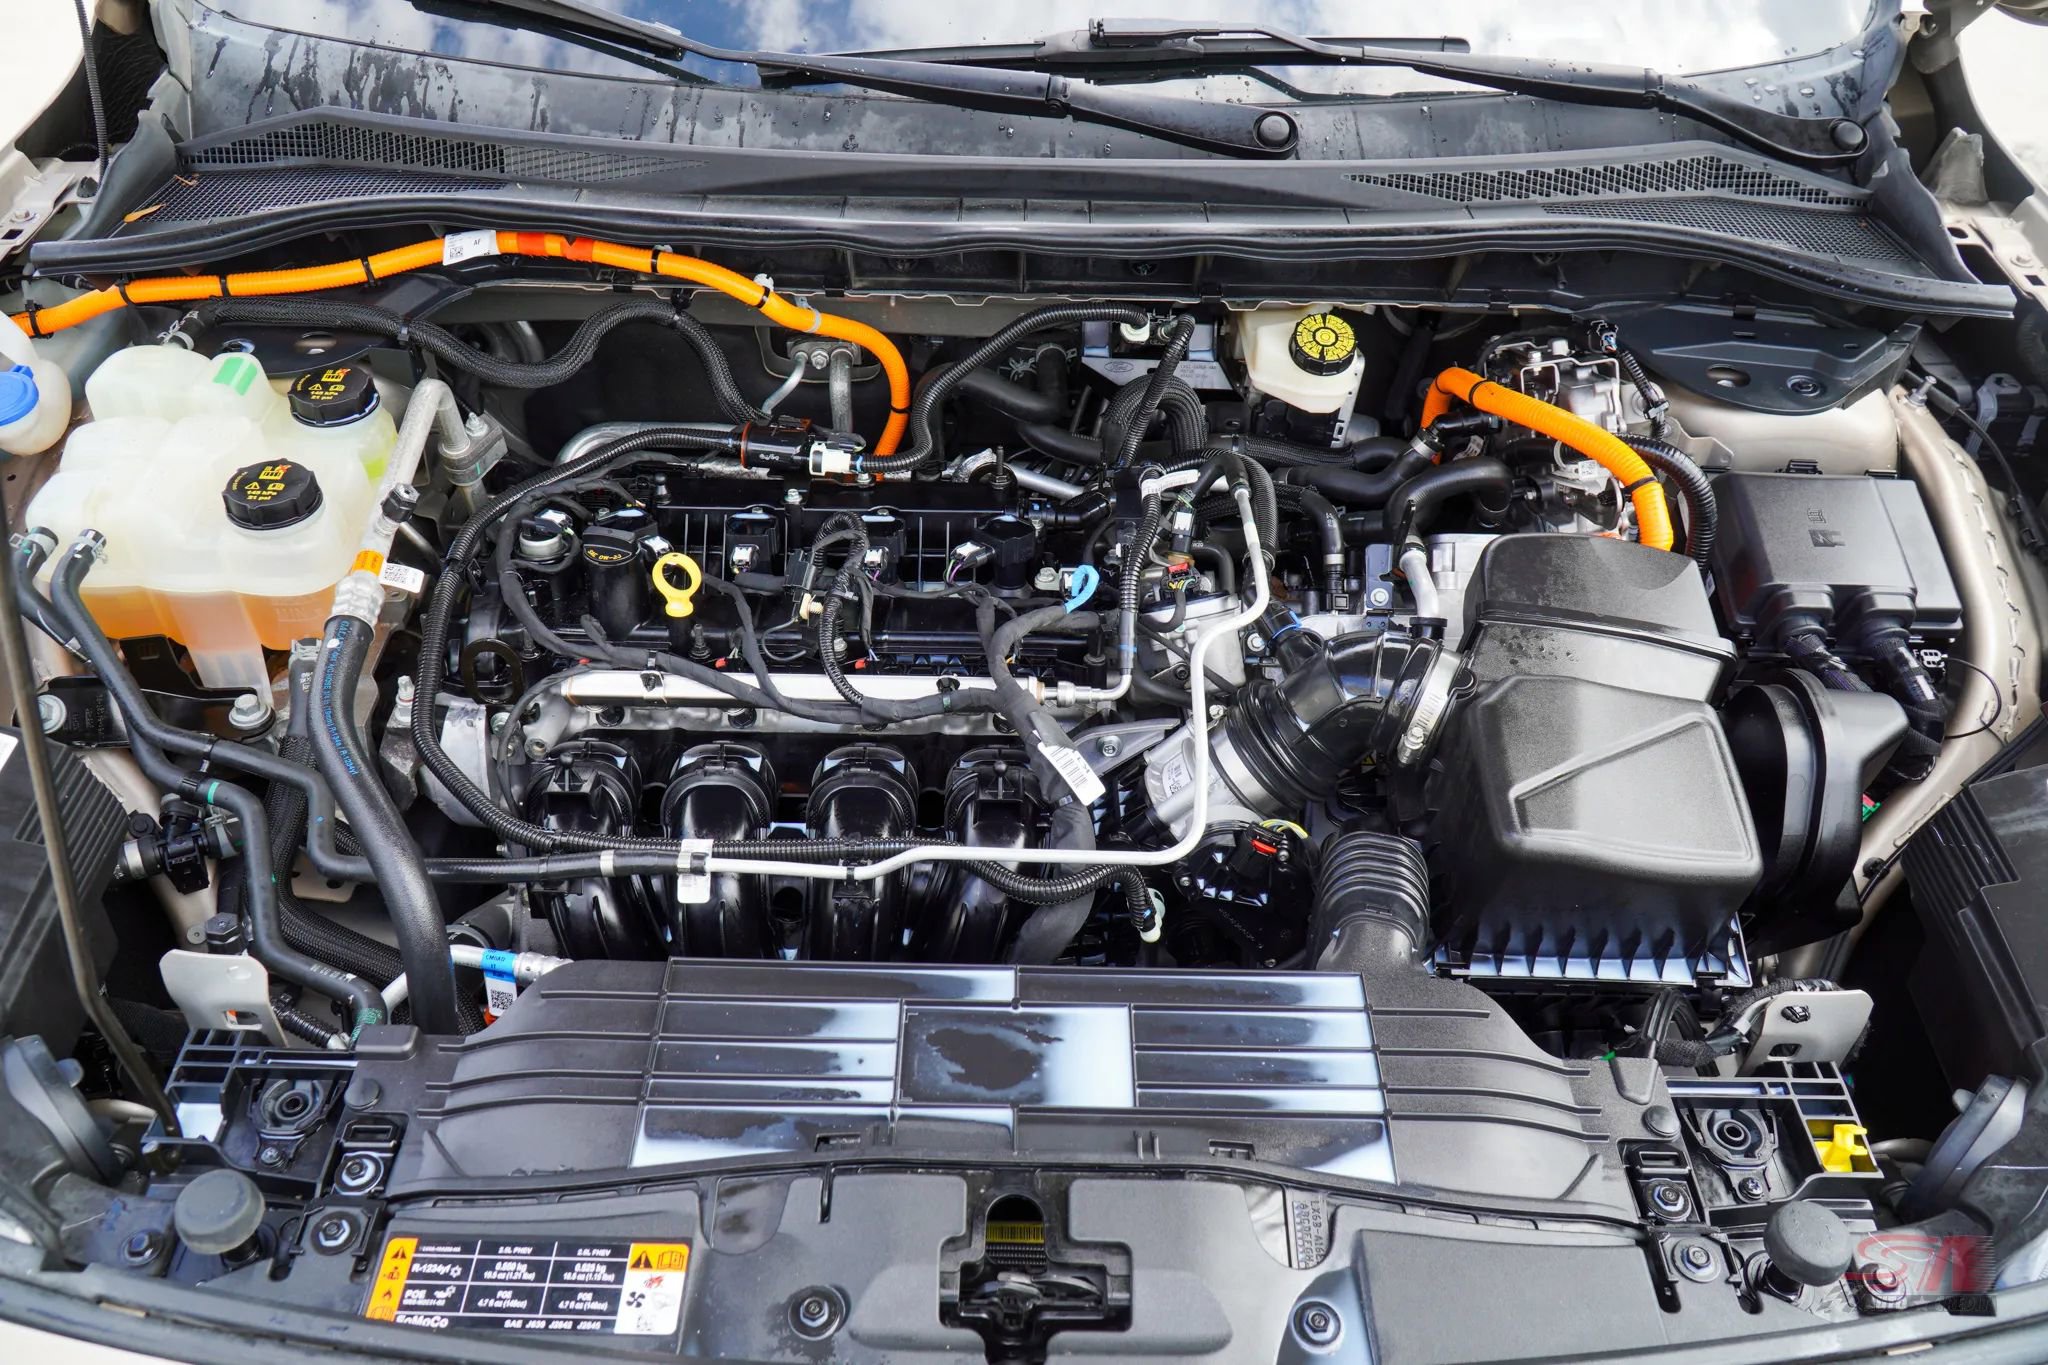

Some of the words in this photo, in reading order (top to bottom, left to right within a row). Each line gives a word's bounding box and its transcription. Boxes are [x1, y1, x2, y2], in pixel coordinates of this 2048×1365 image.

[513, 1246, 533, 1254] PHEV
[592, 1249, 611, 1257] PHEV
[411, 1263, 452, 1275] R-1234yf
[516, 1262, 528, 1273] kg
[596, 1263, 607, 1274] kg
[405, 1289, 427, 1299] POE
[504, 1319, 523, 1328] SAE
